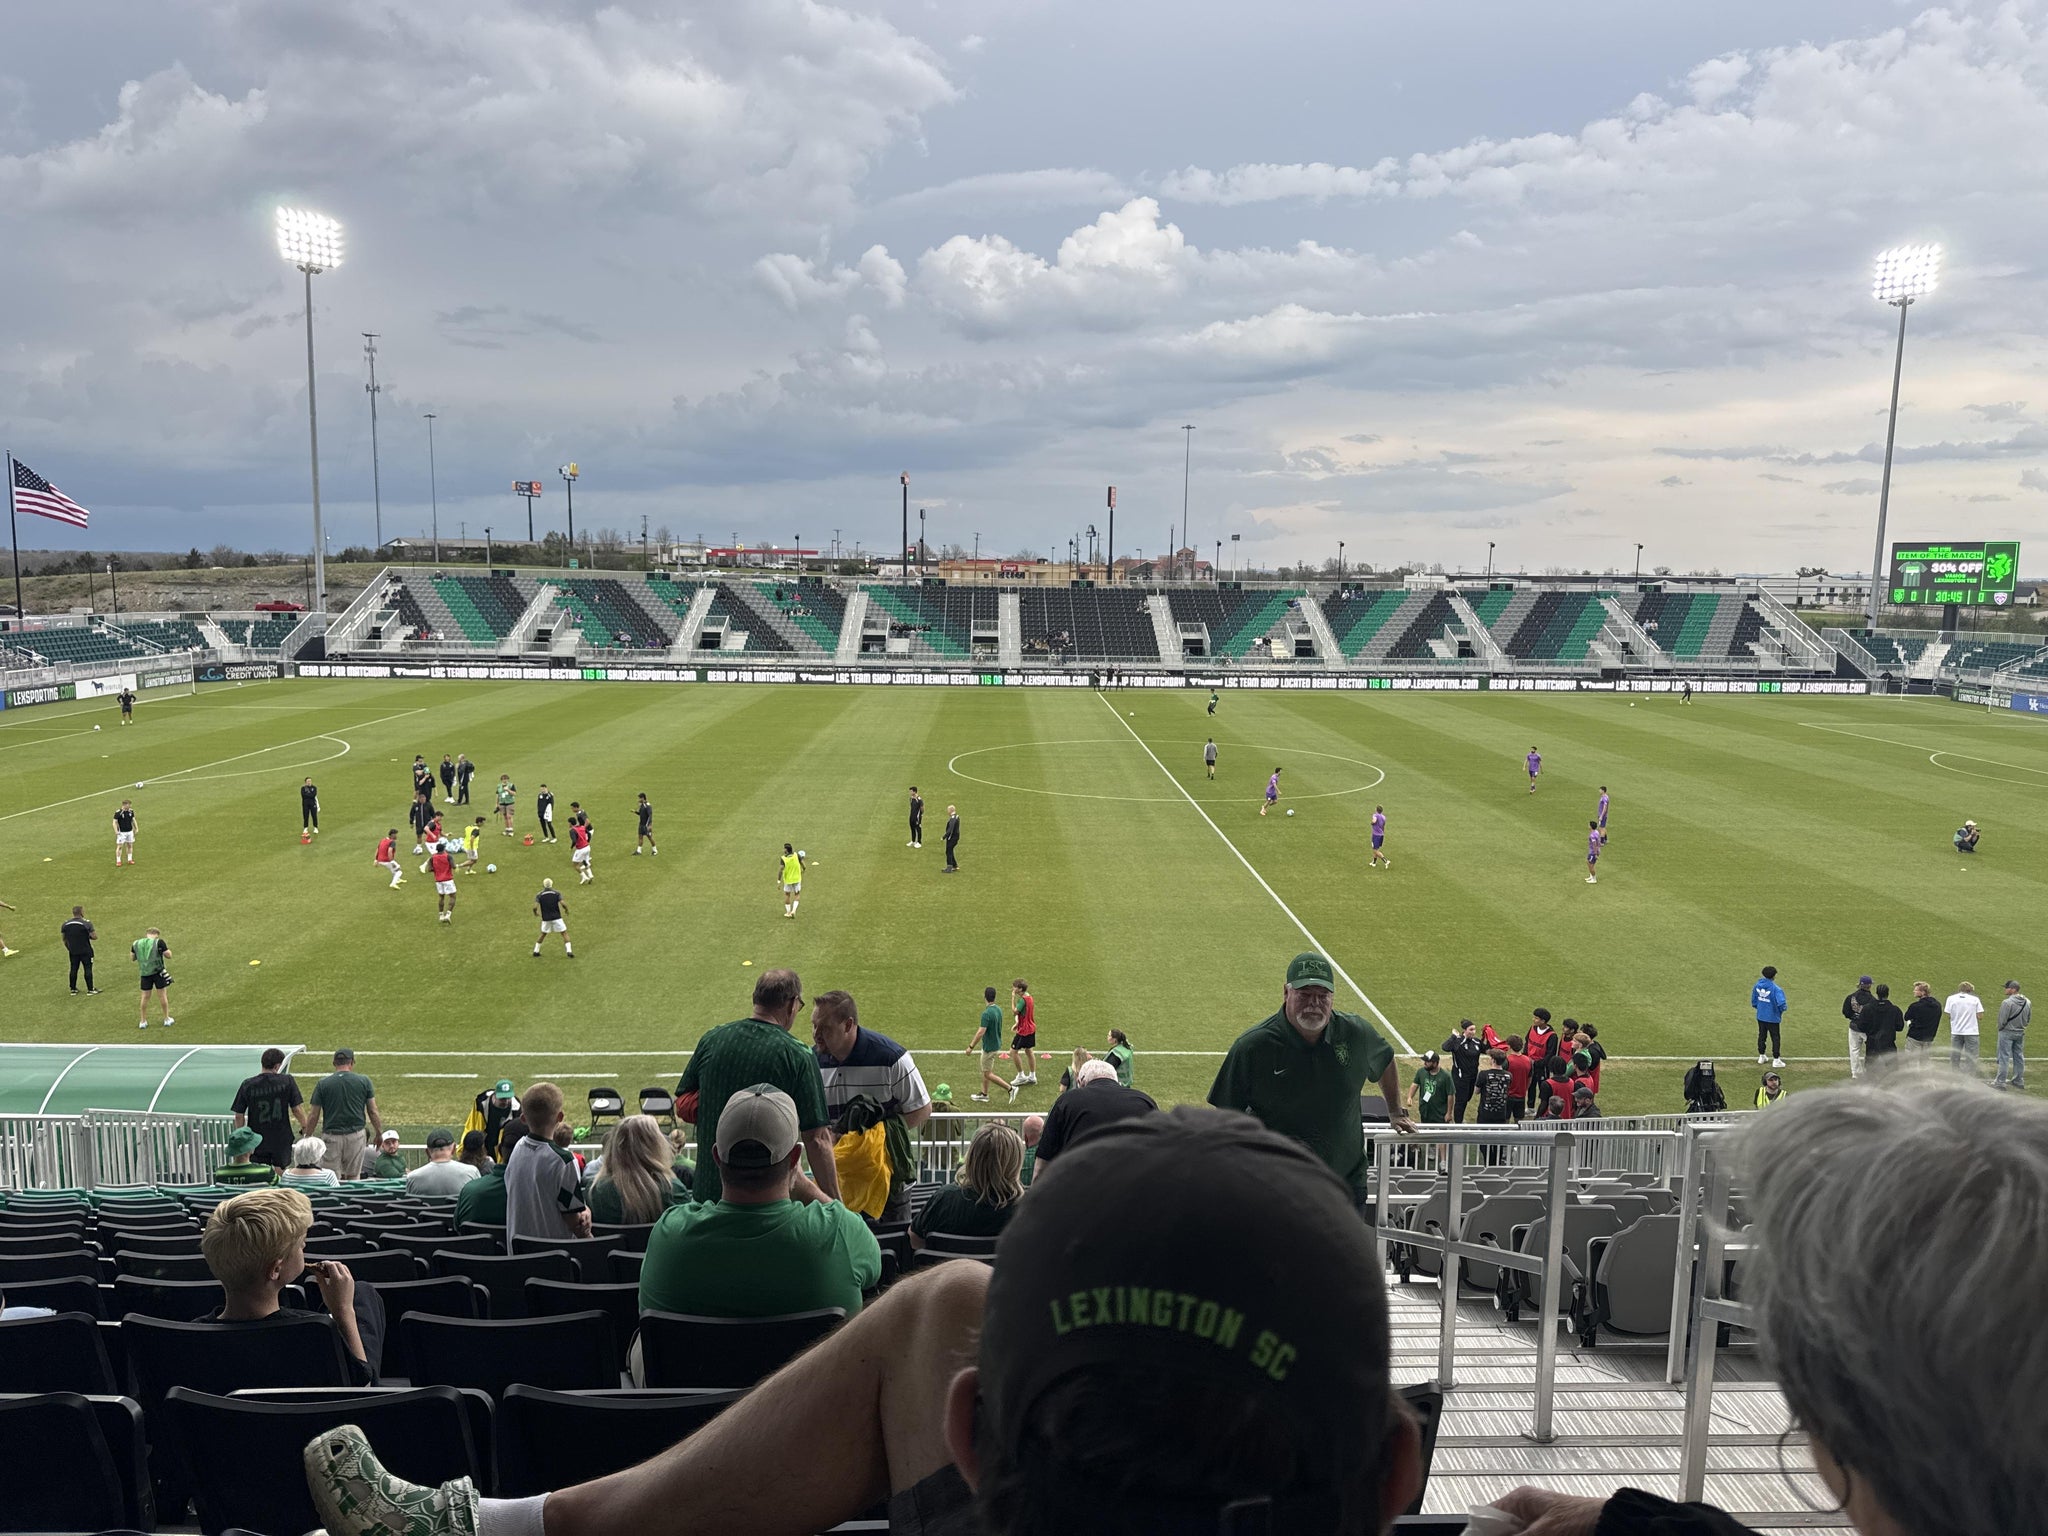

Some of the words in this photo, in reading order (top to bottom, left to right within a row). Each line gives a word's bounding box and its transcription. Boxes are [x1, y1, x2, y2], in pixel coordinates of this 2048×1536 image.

[1931, 562, 1957, 573] 30%
[1958, 562, 1983, 573] OFF
[1910, 591, 1917, 601] 0
[1978, 592, 1985, 603] 0
[225, 665, 278, 673] COMMONWEALTH
[299, 665, 318, 677] GEAR
[319, 665, 330, 677] UP
[331, 665, 346, 677] FOR
[431, 667, 446, 678] LSC
[447, 667, 468, 678] TEAM
[469, 667, 489, 679] SHOP
[490, 668, 522, 679] LOCATED
[523, 668, 550, 679] BEHIND
[551, 668, 582, 680] SECTION
[596, 669, 606, 681] OR
[225, 671, 252, 680] CREDIT
[253, 670, 278, 679] UNION
[707, 670, 726, 682] GEAR
[727, 671, 738, 682] UP
[738, 671, 753, 682] FOR
[835, 673, 850, 683] LSC
[850, 673, 871, 683] TEAM
[872, 673, 891, 684] SHOP
[892, 673, 923, 684] LOCATED
[924, 674, 949, 684] BEHIND
[950, 674, 979, 685] SECTION
[993, 674, 1003, 685] OR
[1130, 676, 1143, 687] FOR
[1224, 677, 1239, 688] LSC
[1239, 677, 1259, 688] TEAM
[1260, 677, 1279, 688] SHOP
[1280, 678, 1311, 688] LOCATED
[1312, 678, 1337, 688] BEHIND
[1338, 678, 1367, 689] SECTION
[1381, 679, 1391, 689] OR
[1489, 679, 1507, 690] GEAR
[1508, 679, 1519, 690] UP
[1520, 679, 1534, 690] FOR
[1615, 680, 1630, 691] LSC
[1630, 680, 1650, 691] TEAM
[1651, 681, 1671, 692] SHOP
[1671, 681, 1702, 692] LOCTED
[1702, 681, 1728, 692] BEHIND
[1728, 681, 1757, 692] SECTION
[1771, 682, 1781, 692] OR
[1050, 1286, 1245, 1349] LEXINGTON
[1249, 1329, 1297, 1381] SC
